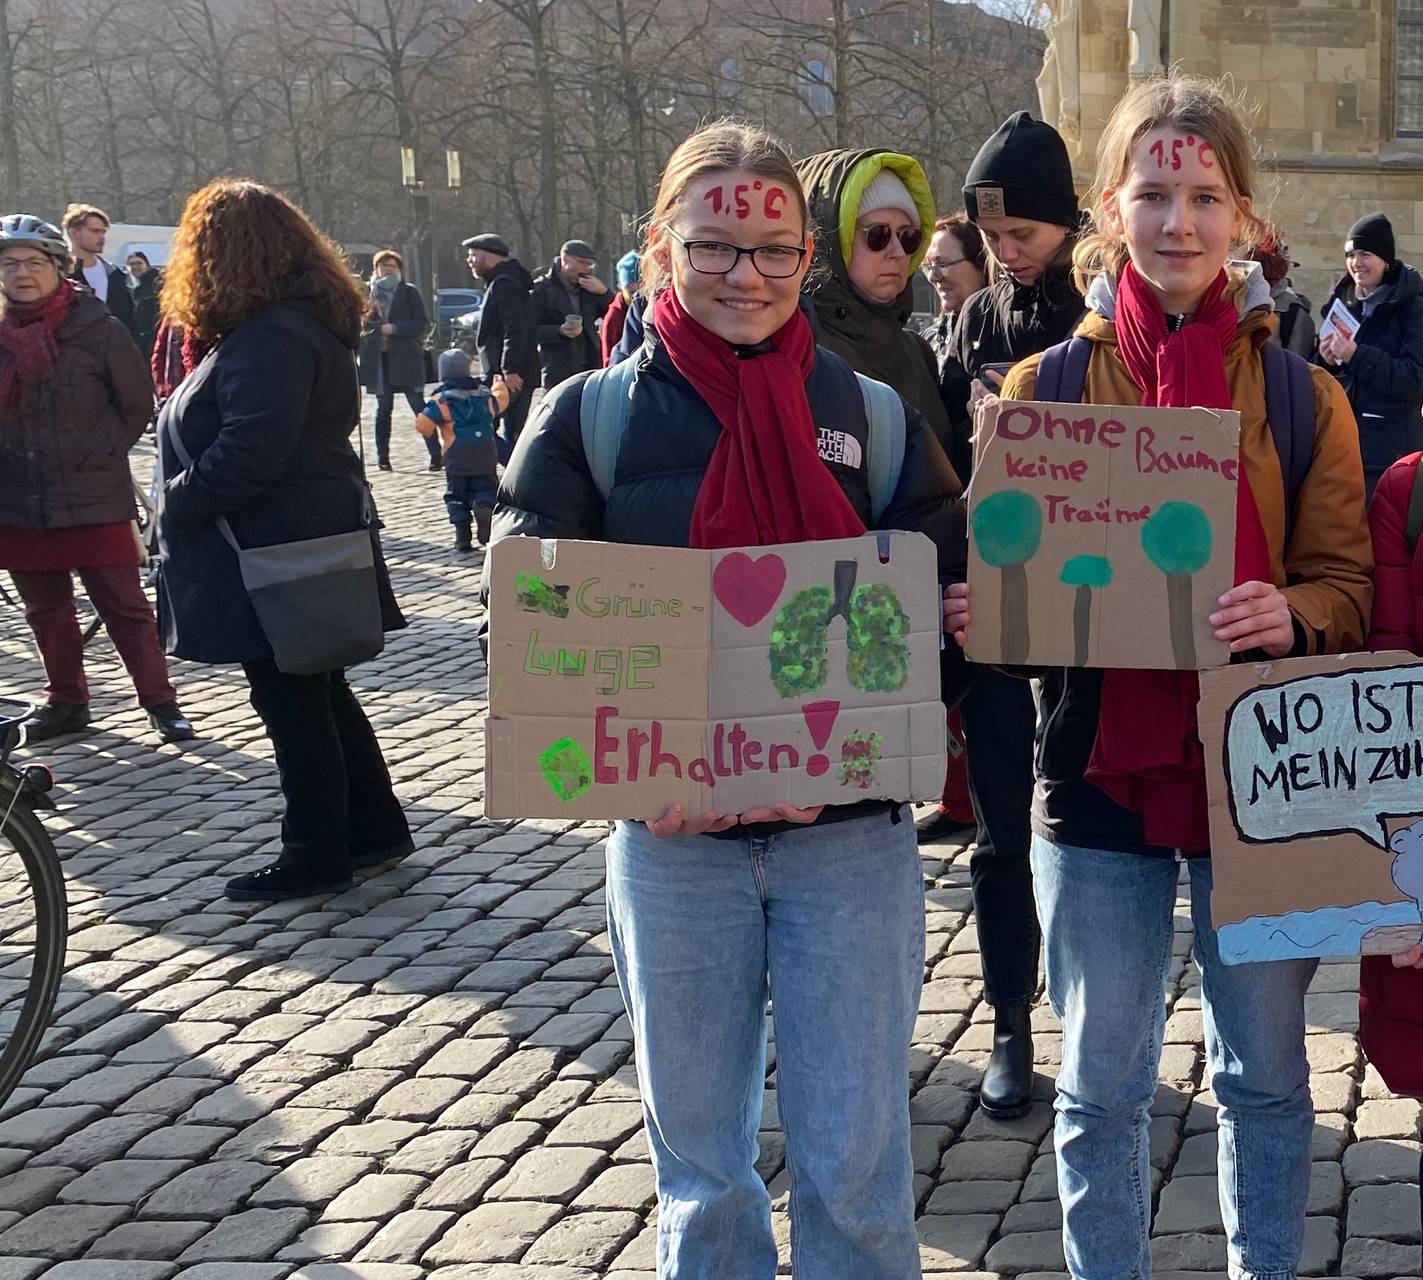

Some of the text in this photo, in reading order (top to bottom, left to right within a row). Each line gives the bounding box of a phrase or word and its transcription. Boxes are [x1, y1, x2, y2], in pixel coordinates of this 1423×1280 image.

[703, 180, 787, 219] 1,5°C
[817, 437, 845, 453] RTH
[818, 427, 845, 443] THE
[996, 406, 1127, 449] Ohne
[818, 448, 843, 464] ACE
[1253, 690, 1323, 754] WO
[594, 700, 841, 789] Erhalten!
[1249, 745, 1358, 805] MEIN
